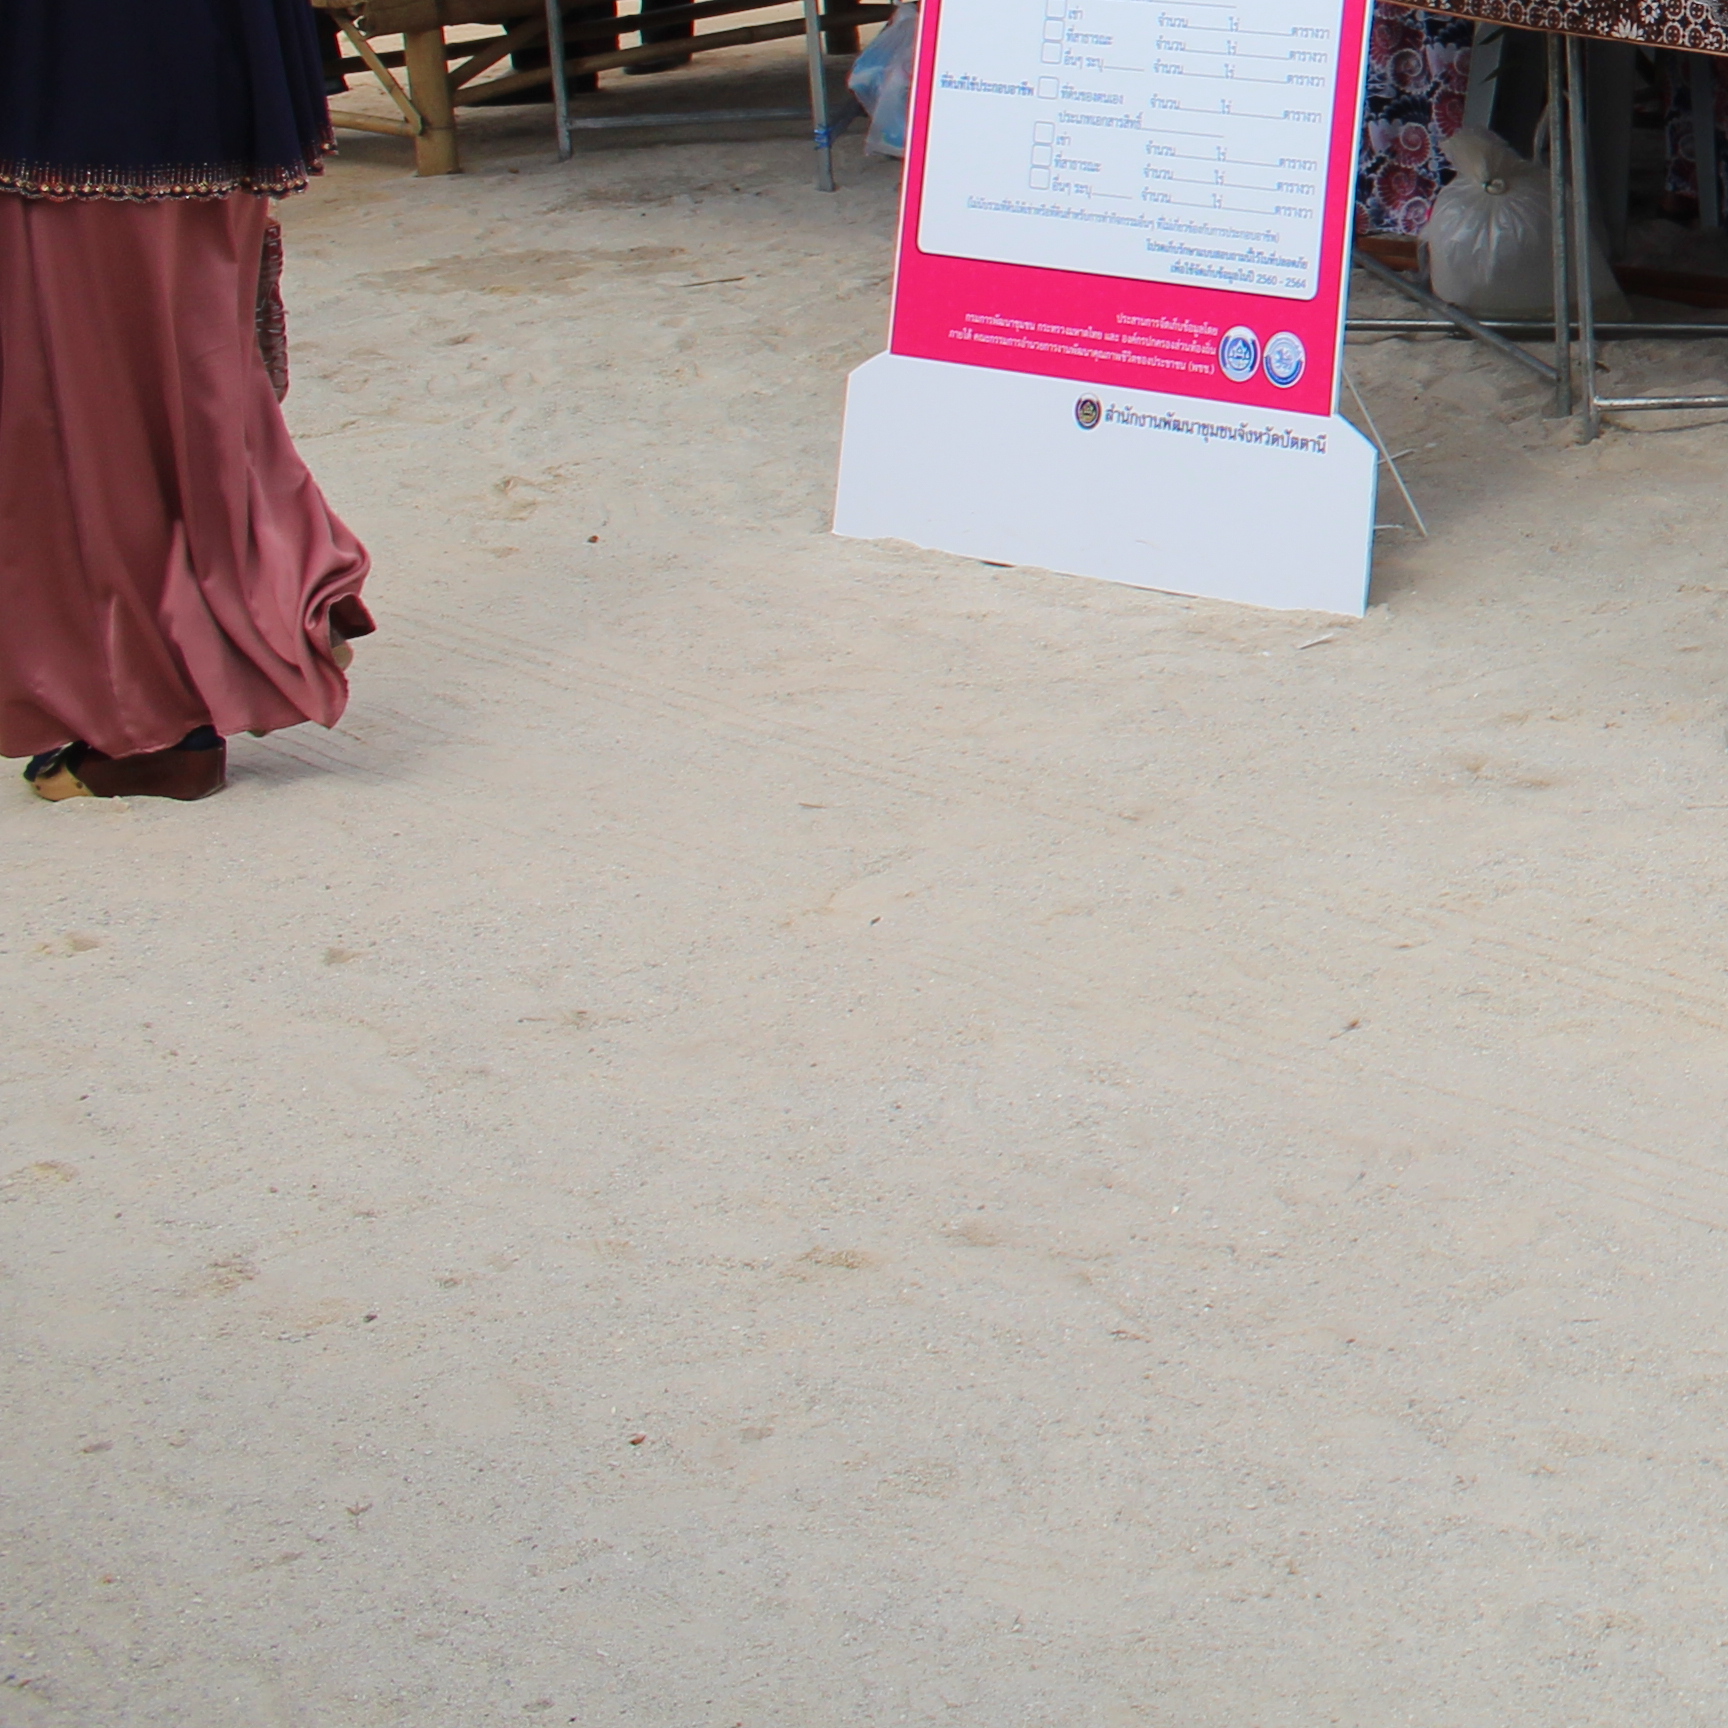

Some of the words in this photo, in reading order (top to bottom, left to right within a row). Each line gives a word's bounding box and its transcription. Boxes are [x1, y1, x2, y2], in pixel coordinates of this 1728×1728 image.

[1104, 402, 1327, 454] สำนักงานพัฒนาชุมชนจังหวัดปัตตานี
